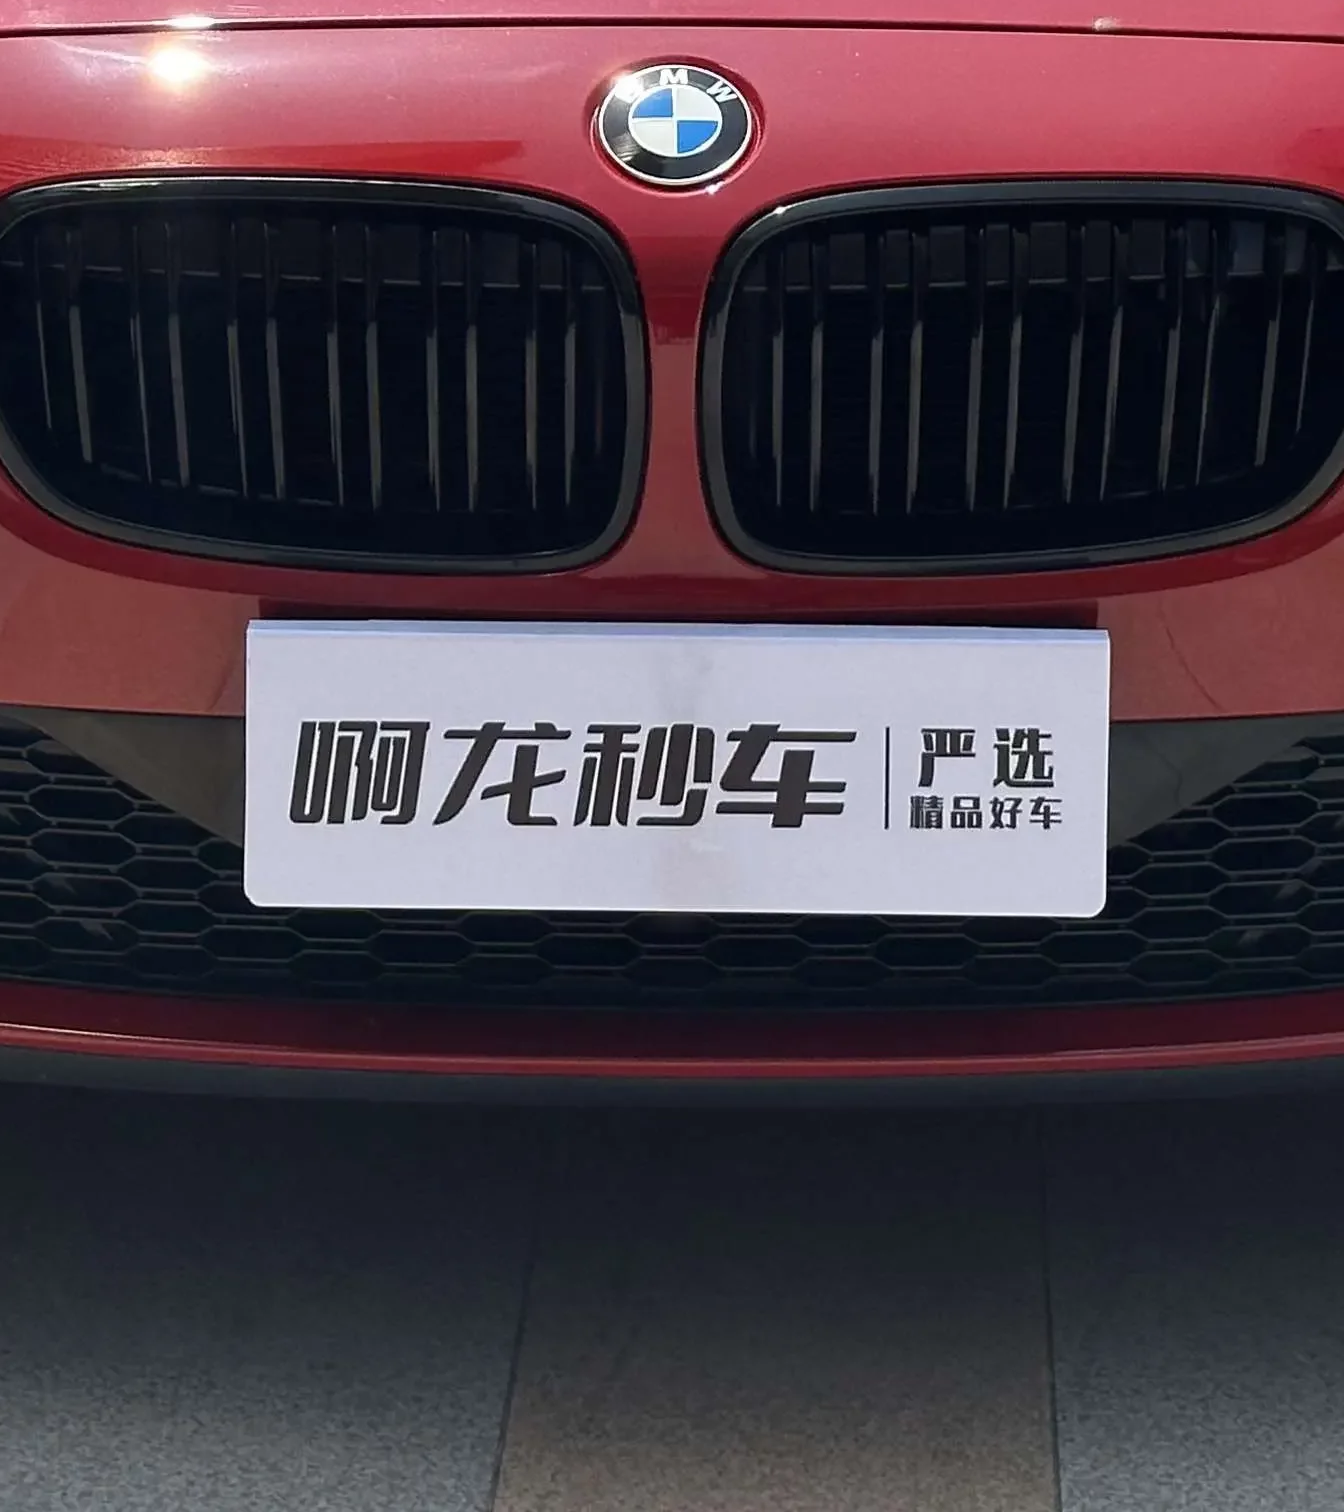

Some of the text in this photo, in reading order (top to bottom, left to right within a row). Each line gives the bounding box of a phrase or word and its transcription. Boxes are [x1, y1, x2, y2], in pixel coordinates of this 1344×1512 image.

[289, 720, 858, 829] 啊龙秒车
[918, 727, 1055, 789] 严选
[909, 795, 1063, 830] 精品好车
